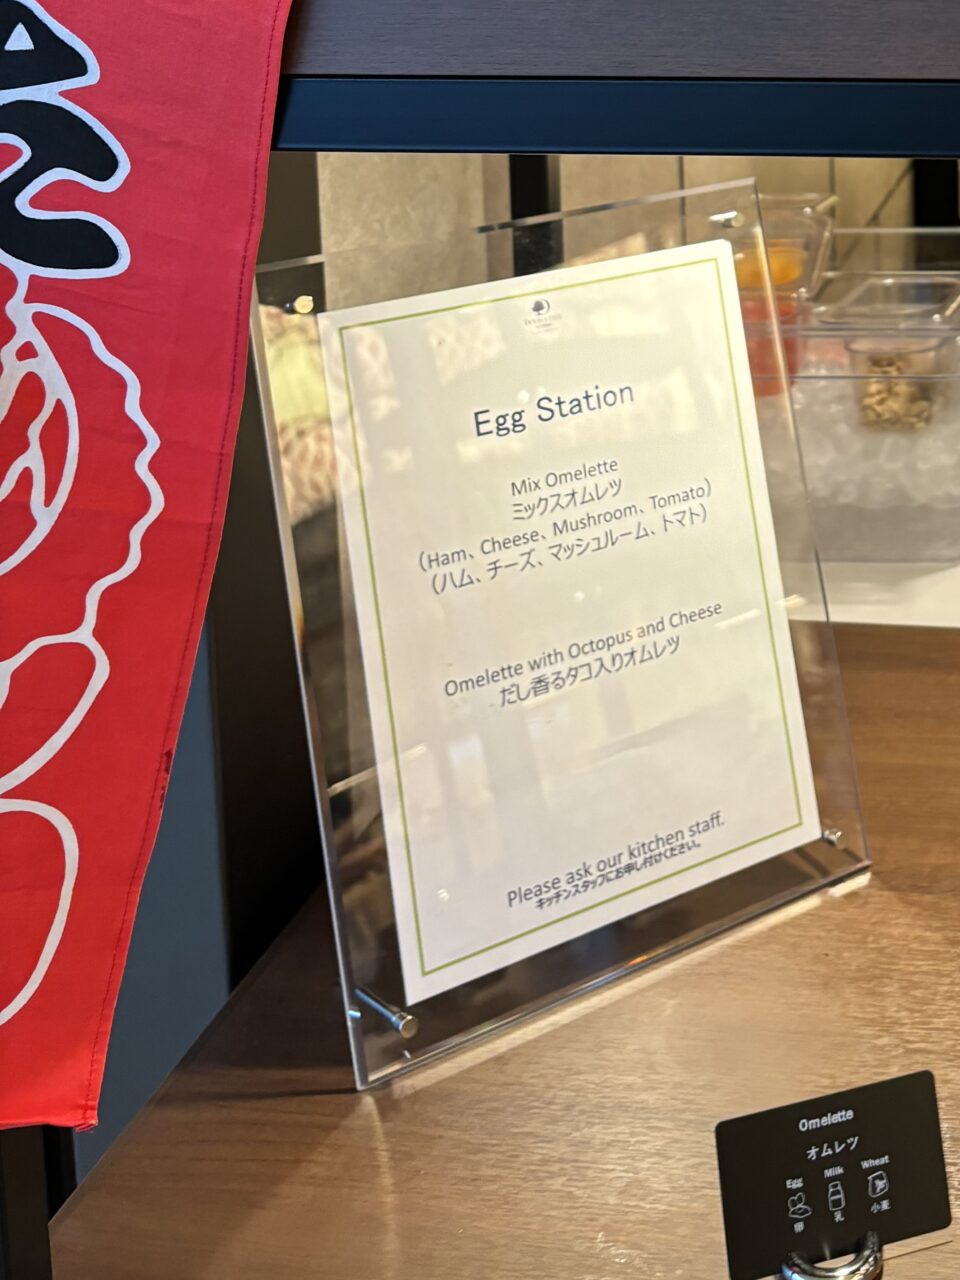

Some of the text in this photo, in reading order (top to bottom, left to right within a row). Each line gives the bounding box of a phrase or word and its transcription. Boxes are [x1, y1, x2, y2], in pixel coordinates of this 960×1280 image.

[473, 385, 634, 437] Egg Station
[511, 460, 619, 496] Mix Omelette
[512, 478, 622, 520] ミックスオムレツ
[445, 603, 723, 696] Omelette with Octopus and Cheese
[500, 635, 680, 707] だし香るタコ入りオムレツ
[507, 810, 725, 907] Please ask our kitchen staff.
[799, 1109, 854, 1132] Omelette
[806, 1136, 859, 1161] オムレツ
